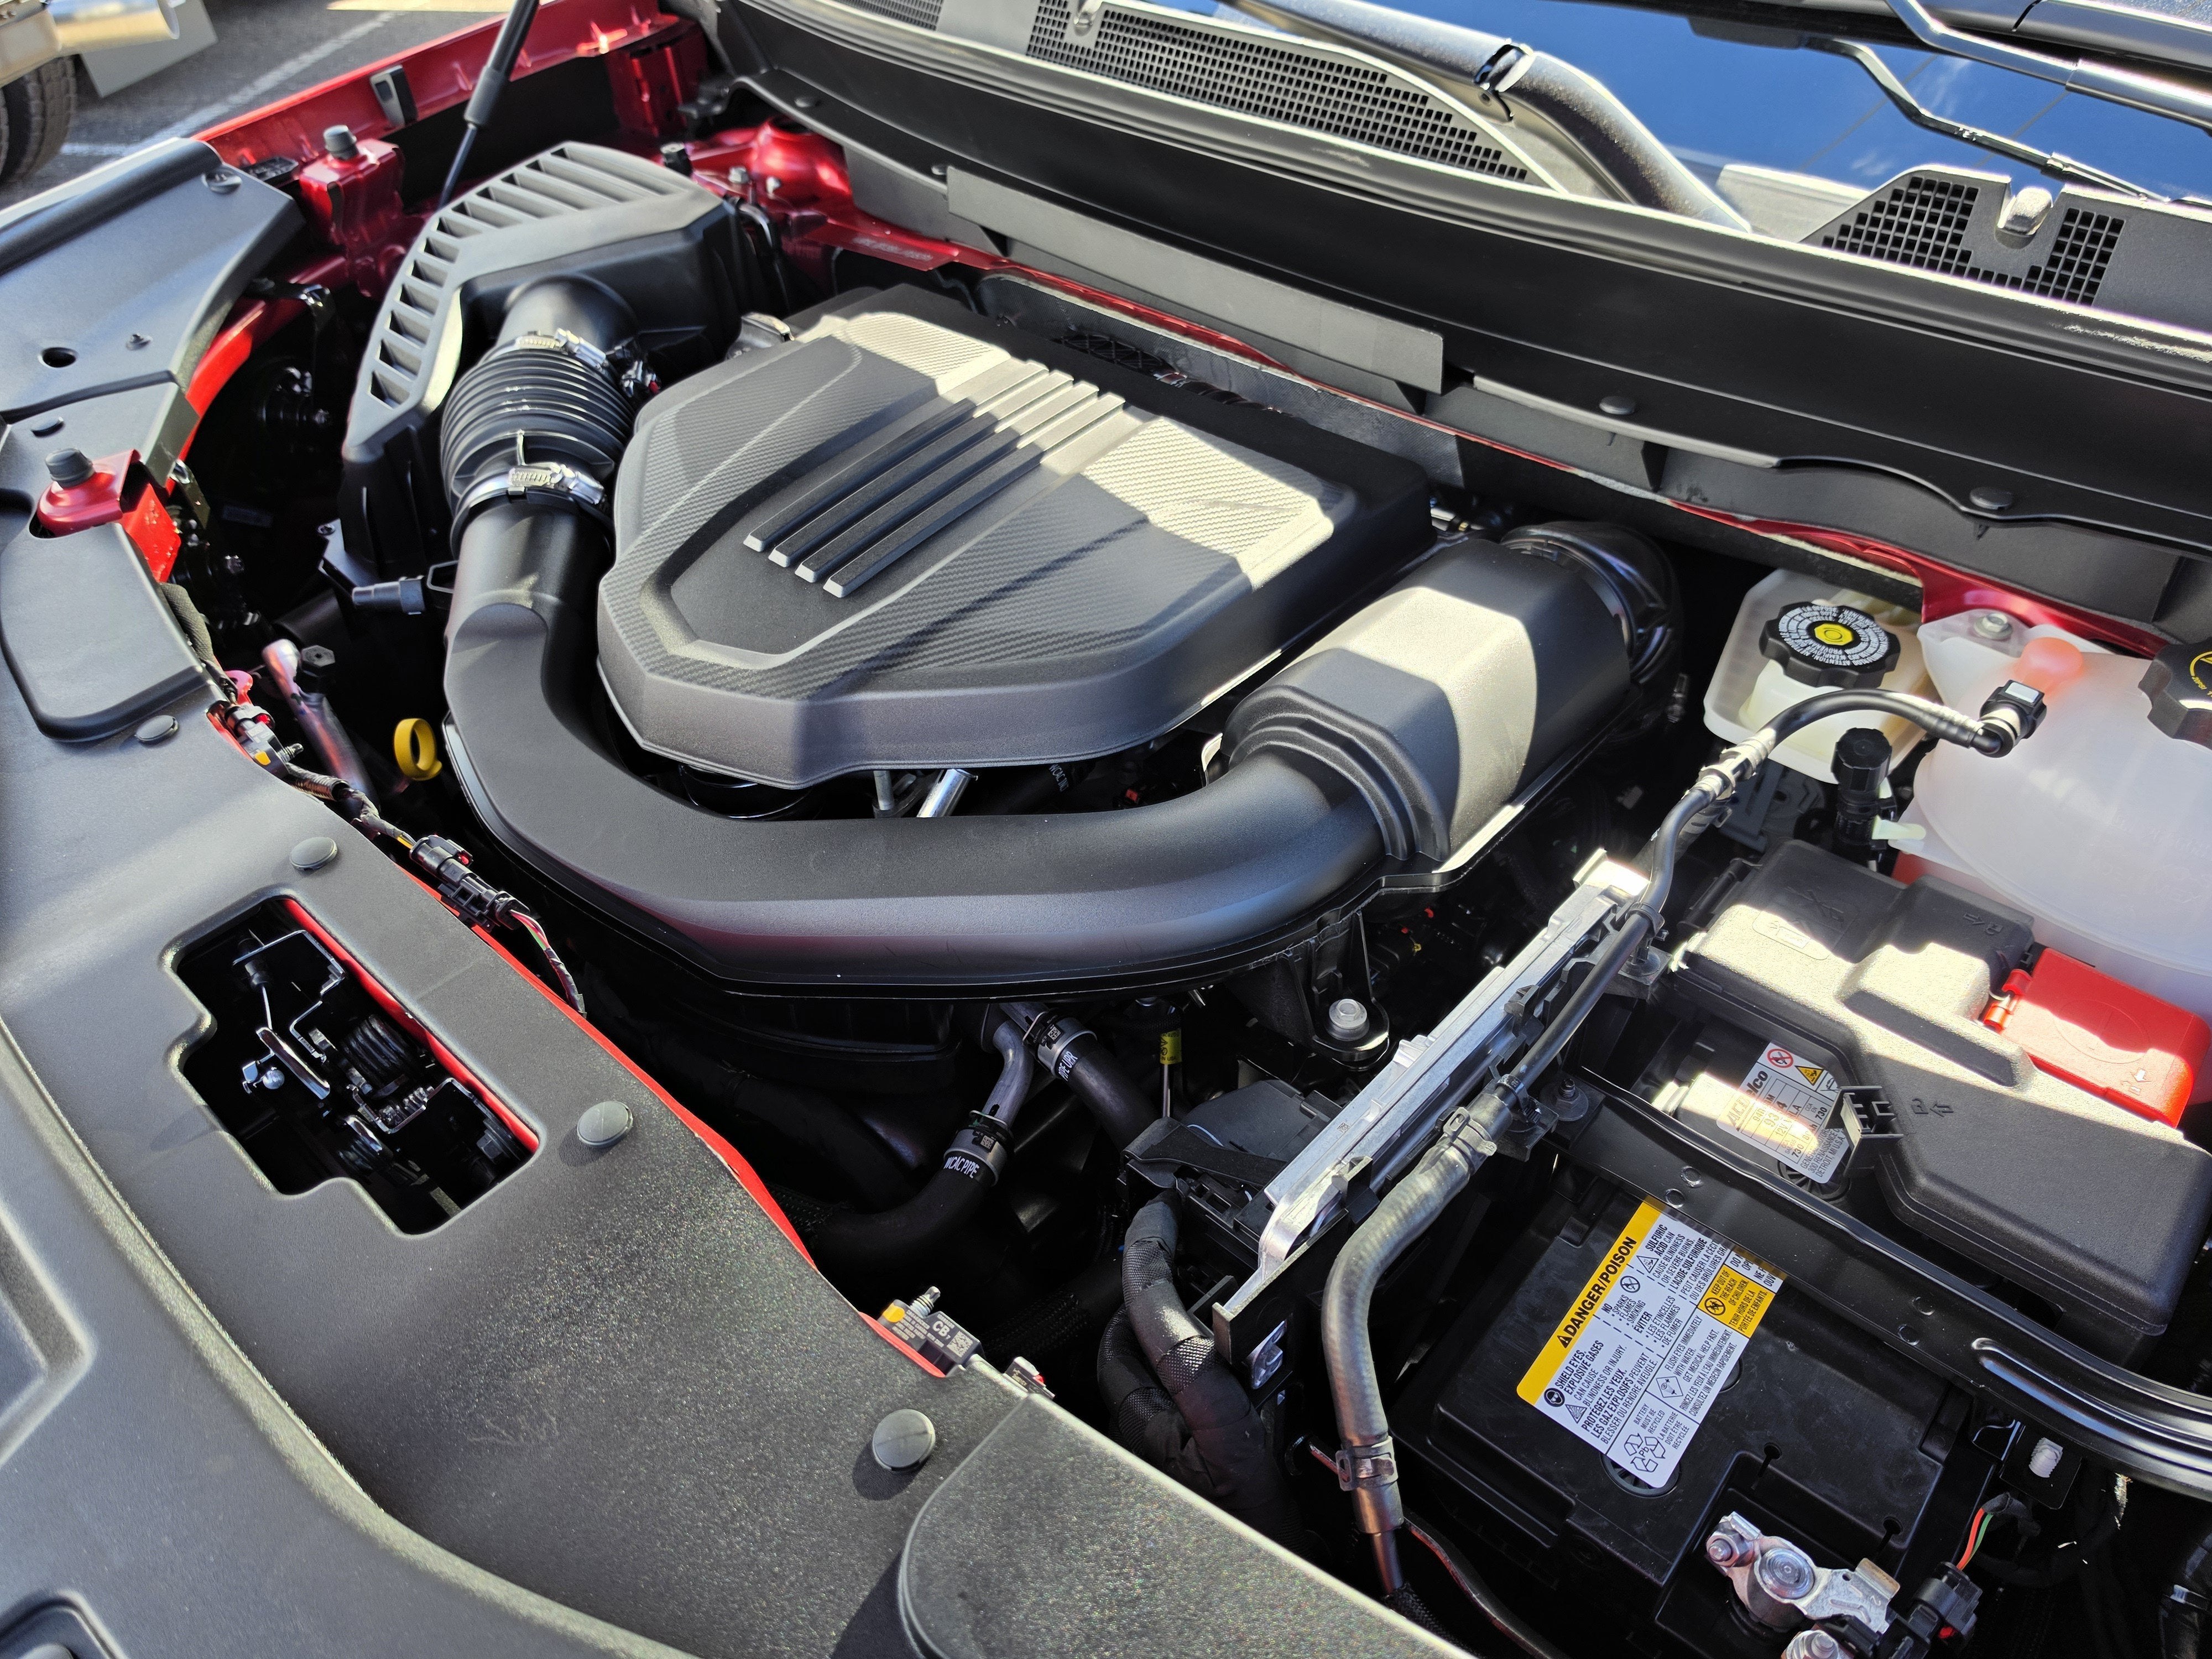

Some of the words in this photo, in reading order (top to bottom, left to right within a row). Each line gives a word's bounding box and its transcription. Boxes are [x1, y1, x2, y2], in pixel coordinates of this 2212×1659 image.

[1061, 1051, 1078, 1068] UPR
[1058, 1062, 1070, 1082] PIPE
[1803, 1102, 1813, 1112] CCA
[1813, 1105, 1828, 1121] 730
[1790, 1142, 1806, 1158] 730
[1811, 1130, 1839, 1164] RENAISSANCE
[1827, 1146, 1838, 1156] MI
[1830, 1133, 1846, 1150] U.S.A.
[960, 1160, 980, 1178] PIPE
[1806, 1161, 1819, 1173] 300
[1813, 1153, 1835, 1177] DETROIT,
[1645, 1223, 1668, 1252] SULFURIC
[1653, 1240, 1668, 1256] ACID
[1662, 1230, 1675, 1244] CAN
[1677, 1236, 1695, 1258] BURNS.
[1652, 1260, 1668, 1279] CAUSE
[1662, 1233, 1686, 1262] BLINDNESS
[1665, 1254, 1683, 1276] SEVERE
[1670, 1267, 1688, 1290] L'ACIDE
[1681, 1237, 1708, 1271] SULFURIQUE
[1729, 1256, 1742, 1267] DO
[1679, 1279, 1694, 1296] PEUT
[1688, 1260, 1707, 1282] CAUSER
[1700, 1253, 1711, 1262] LA
[1698, 1253, 1723, 1282] BRÛLURES
[1721, 1269, 1731, 1277] OF
[1753, 1270, 1765, 1280] NE
[1562, 1235, 1637, 1338] DANGER/POISON
[1660, 1273, 1672, 1284] OR
[1693, 1280, 1706, 1293] DES
[1716, 1274, 1728, 1286] OUT
[1724, 1277, 1738, 1293] REACH
[1689, 1290, 1700, 1301] OU
[1710, 1282, 1723, 1296] KEEP
[1719, 1290, 1730, 1301] THE
[1731, 1277, 1750, 1301] CHILDREN.
[1743, 1295, 1752, 1303] DE
[1746, 1288, 1756, 1298] LA
[1600, 1302, 1613, 1314] NO
[1611, 1293, 1629, 1315] SPARKS
[1619, 1297, 1637, 1319] FLAMES
[1650, 1293, 1676, 1326] ÉTINCELLES
[1728, 1297, 1738, 1306] OF
[1735, 1300, 1749, 1316] HORS
[1750, 1288, 1768, 1311] ENFANTS.
[1626, 1299, 1646, 1324] SMOKING
[1631, 1308, 1653, 1334] ÉVITER
[1728, 1312, 1742, 1328] TENIR
[1746, 1307, 1757, 1317] DE
[932, 1321, 950, 1337] CB
[1645, 1323, 1657, 1336] LES
[1653, 1328, 1666, 1341] LES
[1660, 1303, 1681, 1331] FLAMMES
[1666, 1317, 1683, 1338] FUMER
[1735, 1313, 1753, 1333] PORTÉE
[1661, 1334, 1672, 1346] DE
[1663, 1354, 1679, 1371] FLUSH
[1672, 1342, 1686, 1357] EYES
[1679, 1314, 1703, 1345] IMMEDIATELY
[1705, 1326, 1733, 1363] IMMÉDIATEMENT.
[1706, 1328, 1720, 1343] FAST.
[1699, 1339, 1713, 1354] HELP
[1554, 1364, 1575, 1390] SHIELD
[1568, 1347, 1587, 1368] EYES.
[1563, 1359, 1592, 1395] EXPLOSIVE
[1584, 1338, 1605, 1363] GASES
[1673, 1362, 1686, 1377] WITH
[1680, 1345, 1697, 1366] WATER.
[1687, 1350, 1706, 1374] MEDICAL
[1700, 1359, 1714, 1374] L'EAU
[1582, 1373, 1608, 1407] BLINDNESS
[1601, 1365, 1613, 1376] OR
[1607, 1343, 1627, 1368] INJURY.
[1636, 1357, 1658, 1387] AVEUGLE.
[1682, 1370, 1694, 1383] GET
[1687, 1390, 1708, 1417] CONSULTEZ
[1701, 1384, 1712, 1394] UN
[1715, 1340, 1738, 1370] RAPIDEMENT.
[1692, 1374, 1705, 1389] YEUX
[1573, 1385, 1587, 1401] CAN
[1580, 1367, 1599, 1389] CAUSE
[1687, 1385, 1698, 1396] LES
[1578, 1395, 1608, 1432] PROTÉGEZ
[1600, 1384, 1616, 1400] LES
[1608, 1365, 1628, 1388] YEUX.
[1590, 1422, 1605, 1439] LES
[1598, 1409, 1614, 1426] GAZ
[1606, 1376, 1634, 1413] EXPLOSIFS
[1628, 1352, 1650, 1380] PEUVENT
[1621, 1383, 1642, 1409] RENDRE
[1678, 1392, 1694, 1411] RINCEZ
[1616, 1406, 1628, 1418] OU
[1632, 1402, 1650, 1425] BATTERY
[1640, 1413, 1653, 1430] MUST
[1648, 1407, 1656, 1416] BE
[1647, 1409, 1666, 1434] RECYCLED
[1600, 1415, 1623, 1444] BLESSER
[1661, 1411, 1678, 1434] BATTERIE
[1664, 1431, 1676, 1445] DOIT
[1670, 1419, 1683, 1434] ÊTRE
[1657, 1431, 1666, 1441] LA
[1671, 1424, 1689, 1449] RECYCLÉE
[1638, 1444, 1650, 1458] Pb
